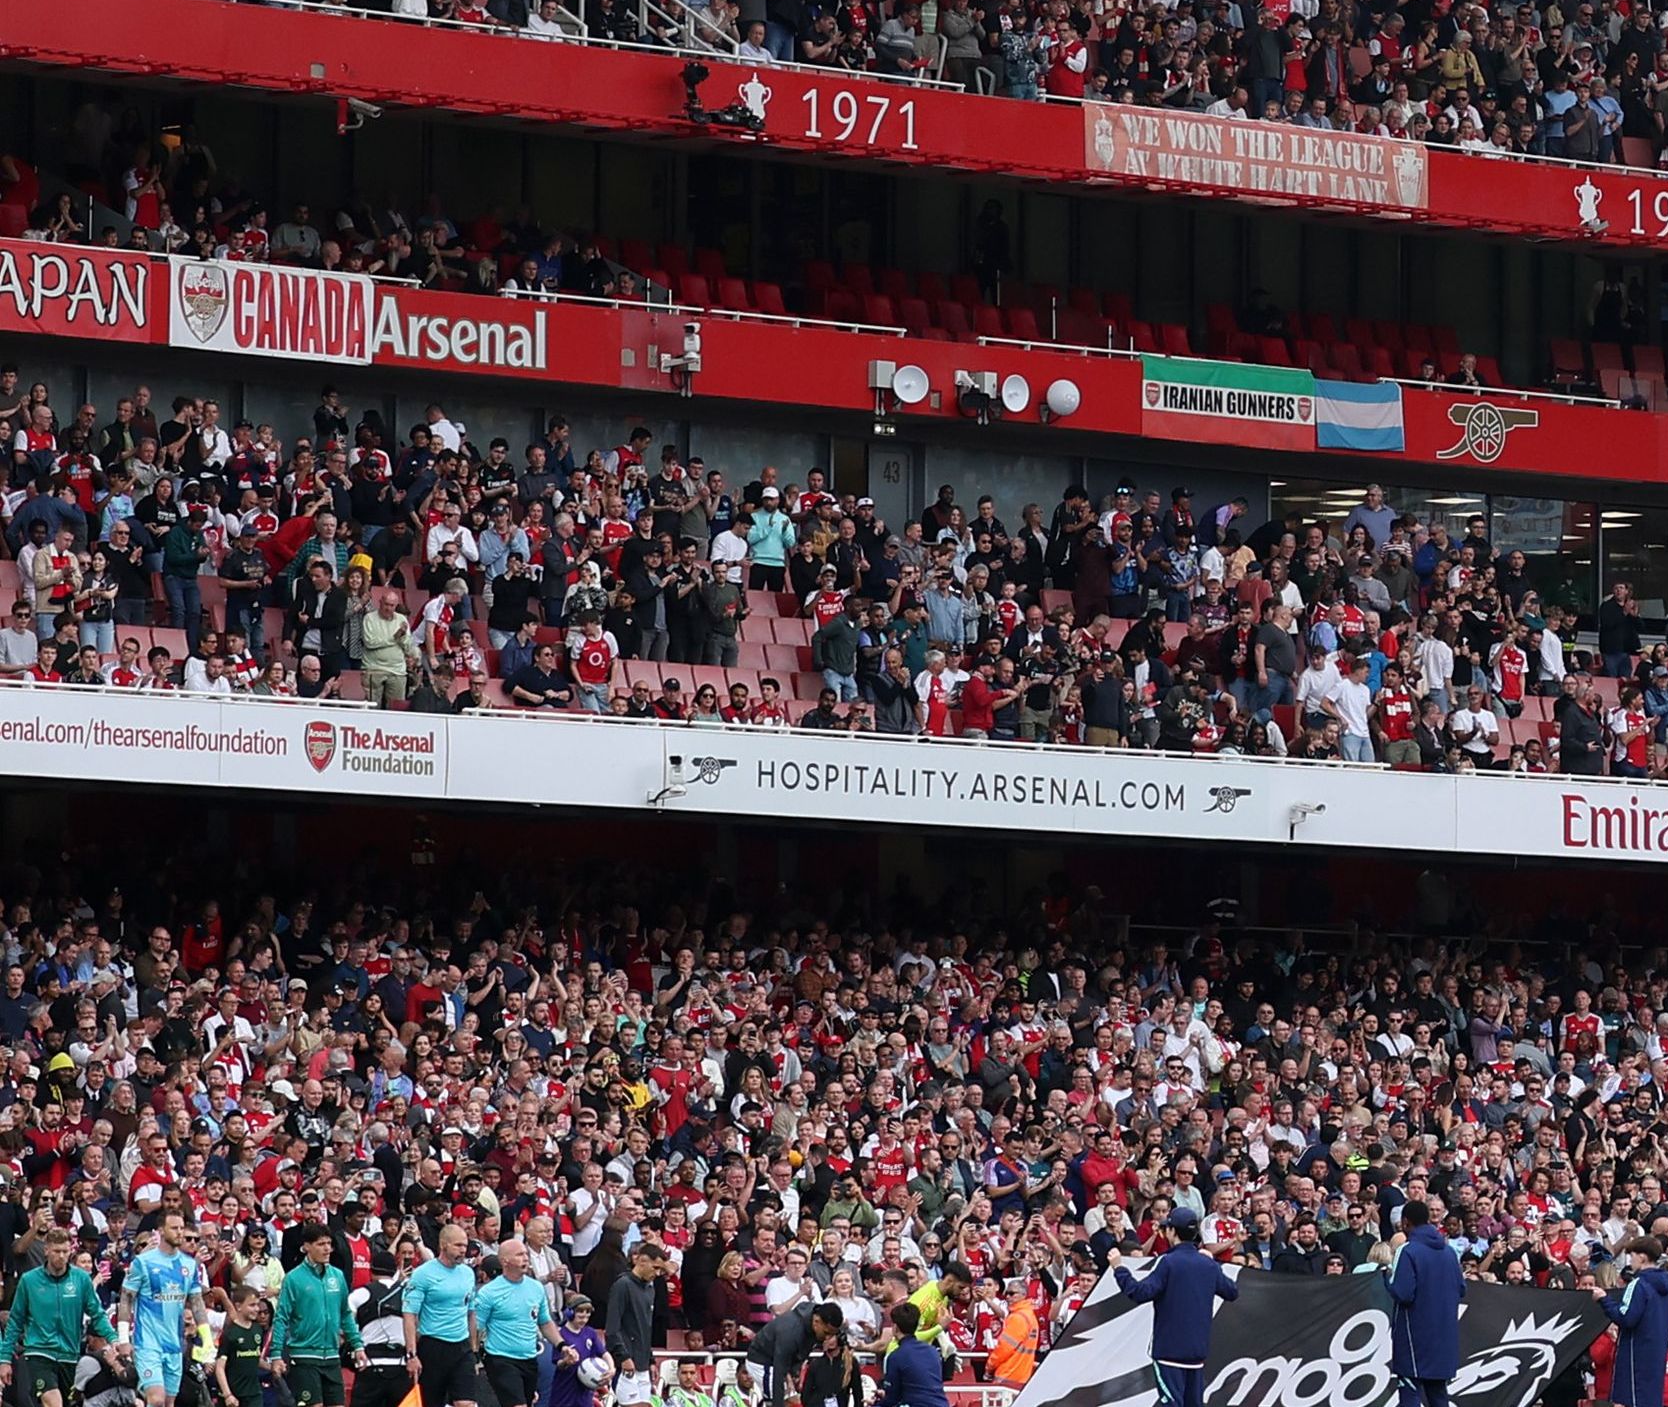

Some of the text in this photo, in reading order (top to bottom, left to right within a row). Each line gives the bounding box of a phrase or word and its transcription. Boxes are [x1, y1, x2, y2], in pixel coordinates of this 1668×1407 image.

[801, 87, 919, 150] 1971
[1119, 113, 1385, 175] WE WON THE LEAGUE
[1157, 152, 1243, 188] WHITE
[1250, 164, 1323, 195] HART
[1328, 172, 1389, 205] LANE
[0, 248, 147, 328] APAN
[232, 268, 366, 359] CANADA
[371, 295, 547, 370] Arsenal
[1162, 385, 1295, 420] IRANIAN GUNNERS
[883, 462, 901, 483] 43
[340, 725, 435, 754] The Arsenal
[342, 749, 435, 776] Foundation
[757, 758, 1186, 811] HOSPITALITY.ARSENAL.COM
